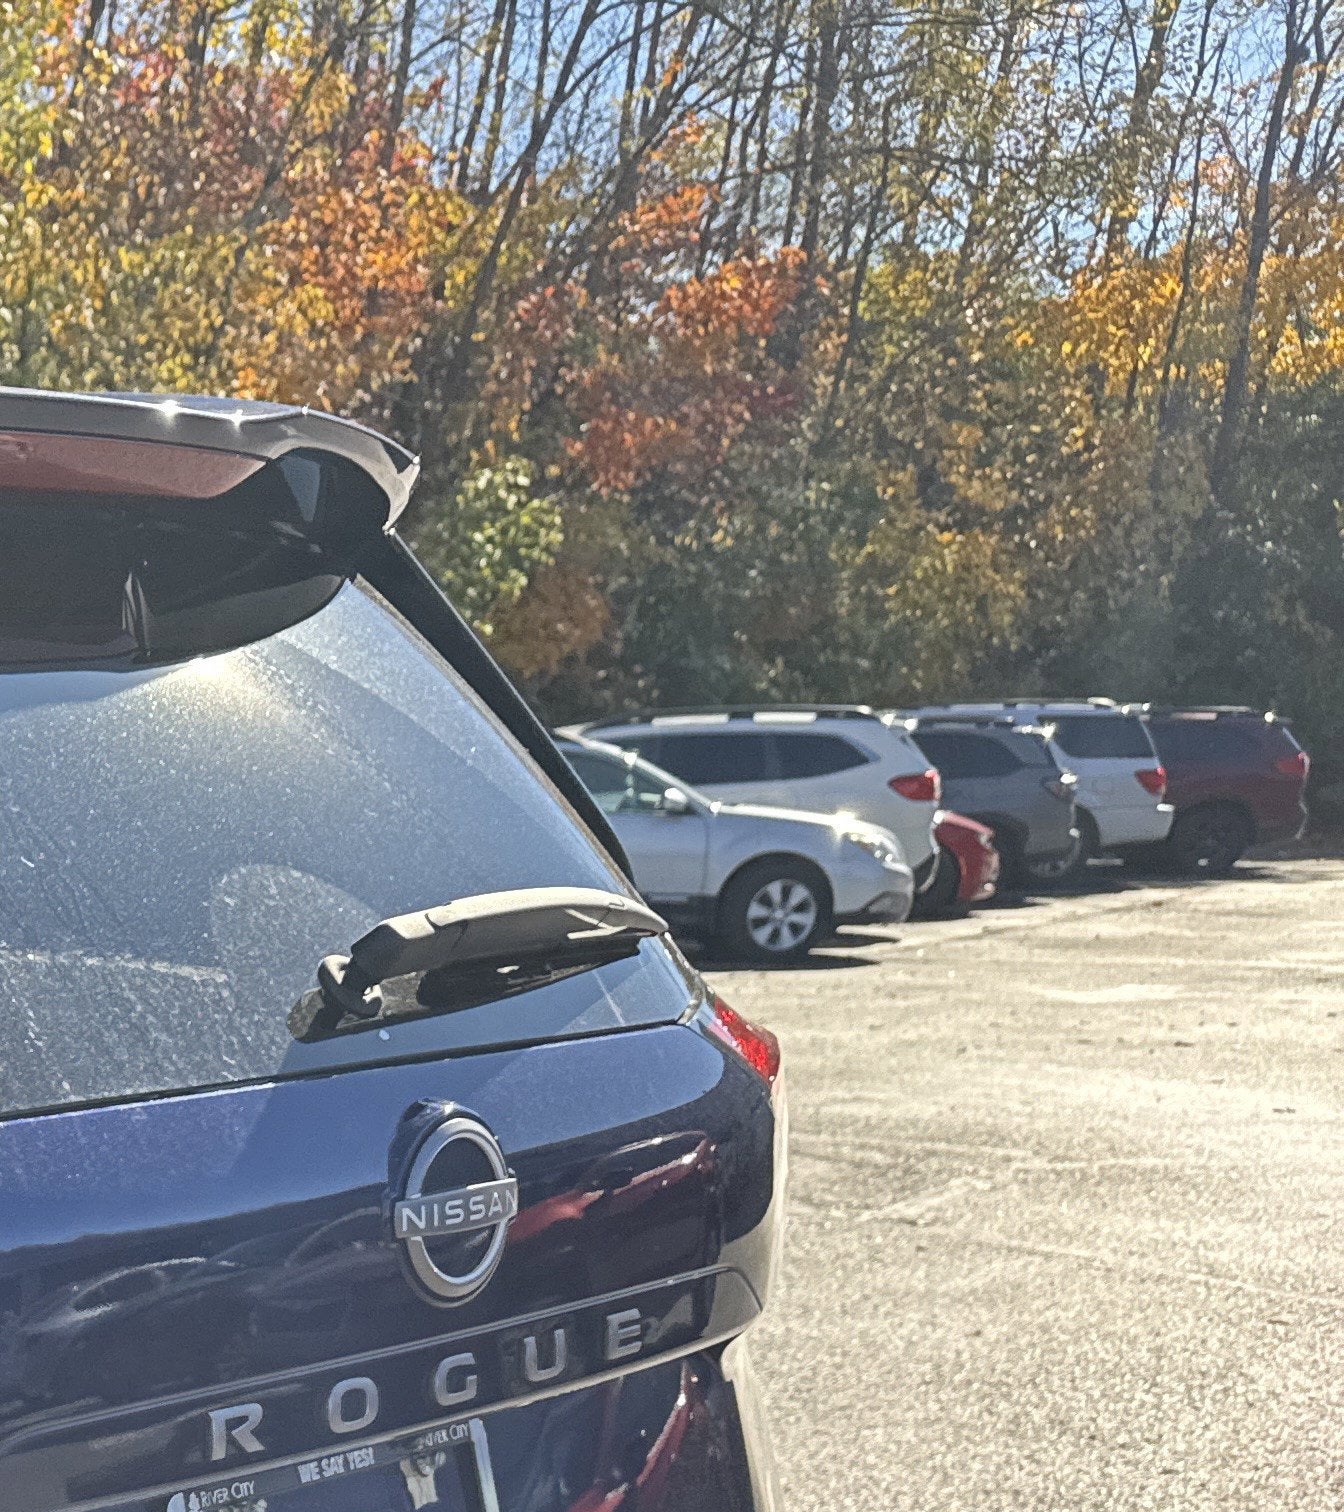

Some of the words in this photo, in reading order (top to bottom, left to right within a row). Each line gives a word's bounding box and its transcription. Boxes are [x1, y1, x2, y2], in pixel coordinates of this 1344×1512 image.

[401, 1189, 518, 1232] NISSAN
[208, 1308, 643, 1462] ROGUE
[297, 1461, 321, 1484] WE
[320, 1454, 345, 1478] SAY
[345, 1446, 375, 1471] YES!
[230, 1480, 255, 1499] CITY
